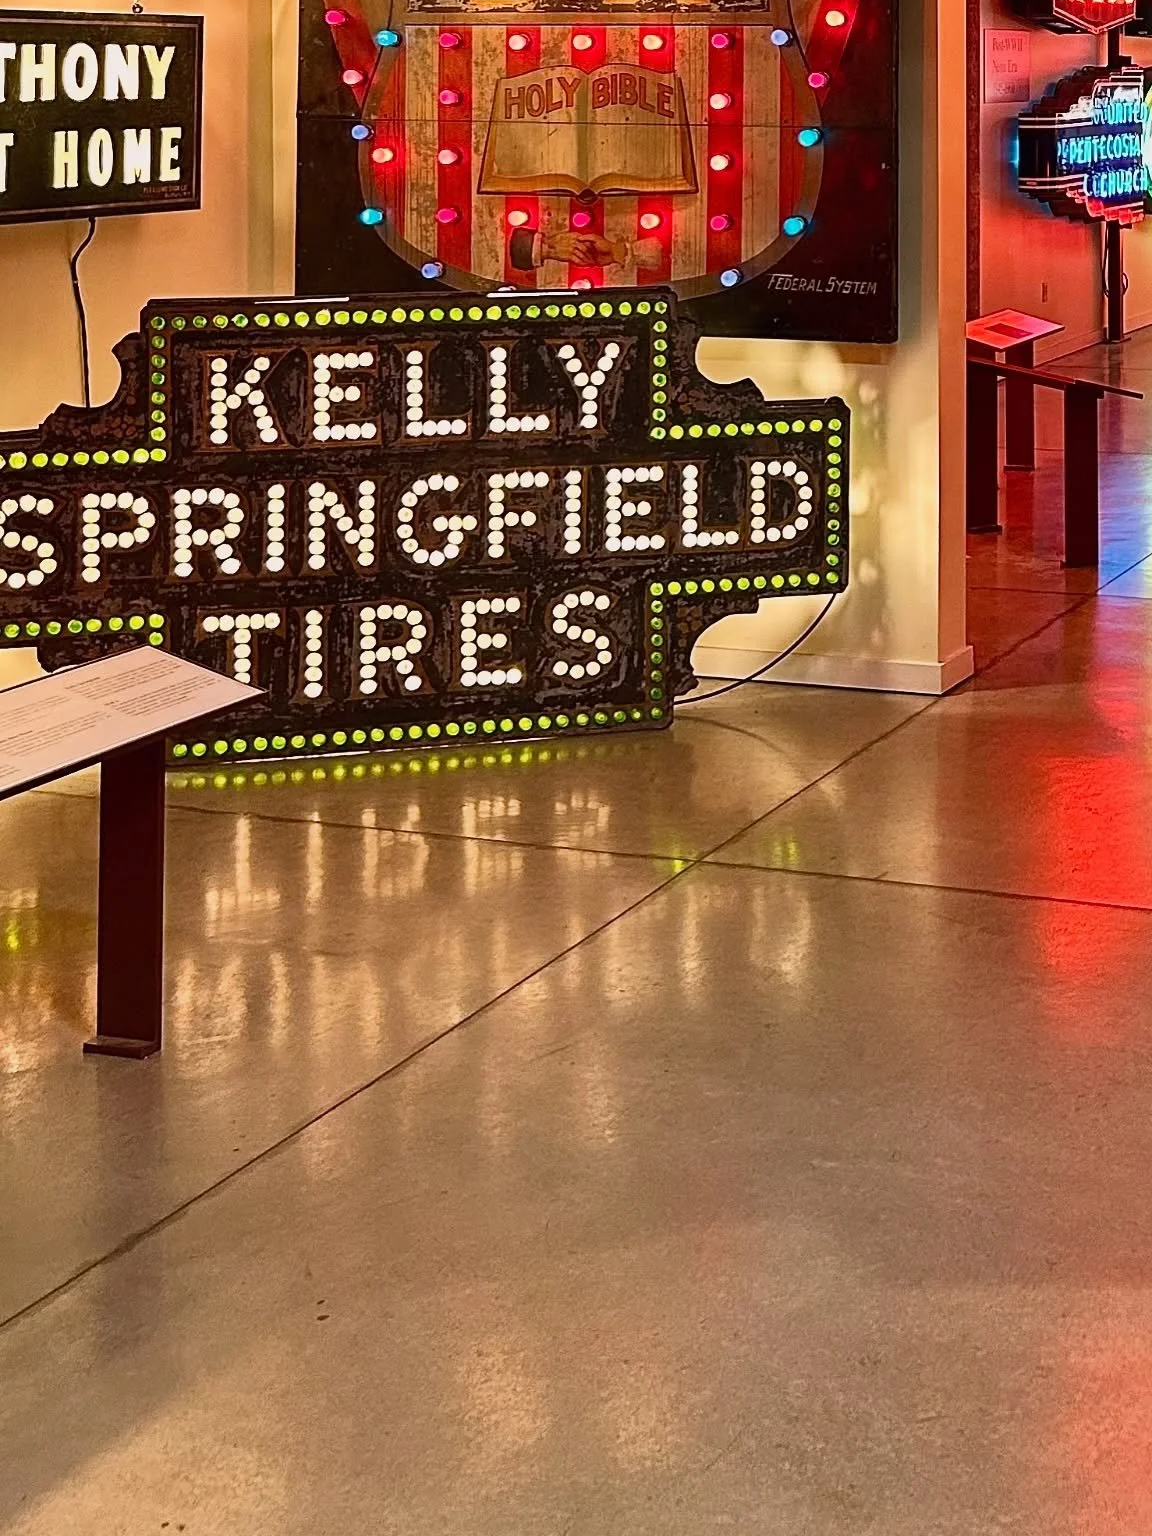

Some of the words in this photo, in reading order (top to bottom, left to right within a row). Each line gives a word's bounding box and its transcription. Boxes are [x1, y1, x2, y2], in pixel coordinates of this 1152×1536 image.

[504, 76, 581, 119] HOLY
[591, 72, 675, 119] BIBLE
[52, 127, 183, 189] HOME
[1069, 133, 1143, 164] PENTECOSTA
[767, 273, 823, 292] FEDERAL
[825, 276, 878, 295] SYSTEM
[203, 340, 627, 448] KELLY
[0, 459, 817, 590] SPRINGFIELD
[200, 589, 613, 700] TIRES
